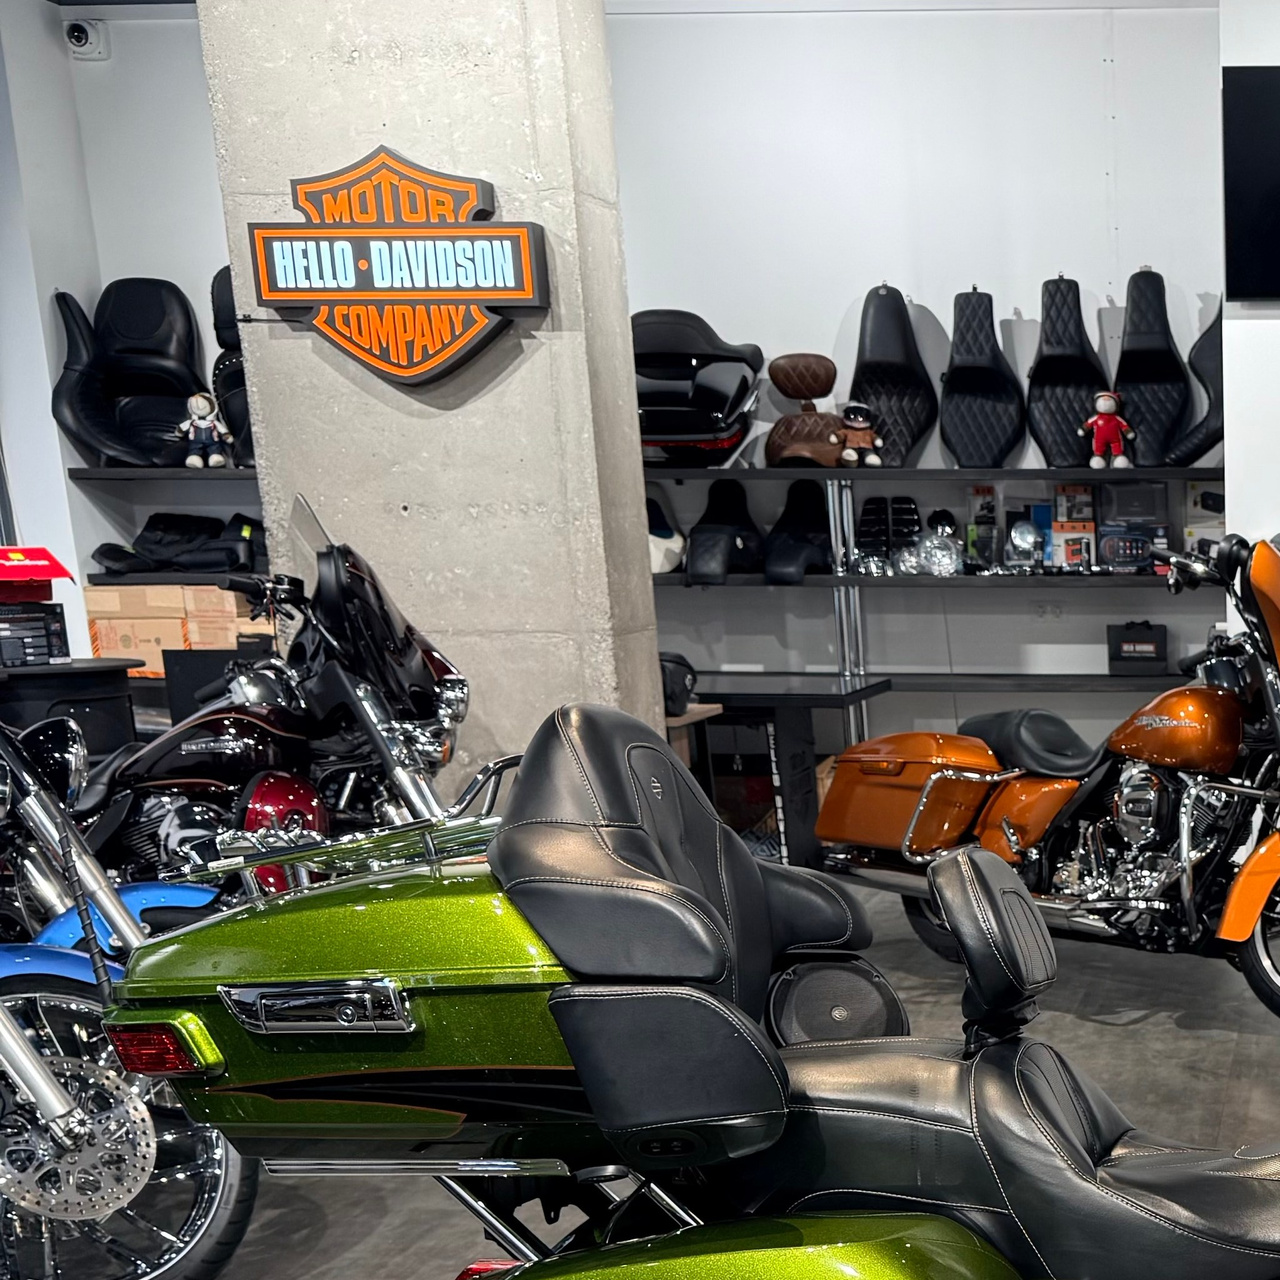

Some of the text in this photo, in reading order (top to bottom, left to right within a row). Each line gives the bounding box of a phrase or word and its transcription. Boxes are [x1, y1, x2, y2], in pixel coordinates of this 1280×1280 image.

[322, 168, 455, 223] MOTOR
[272, 240, 515, 288] HELLO DAVIDSON
[334, 304, 466, 365] COMPANY
